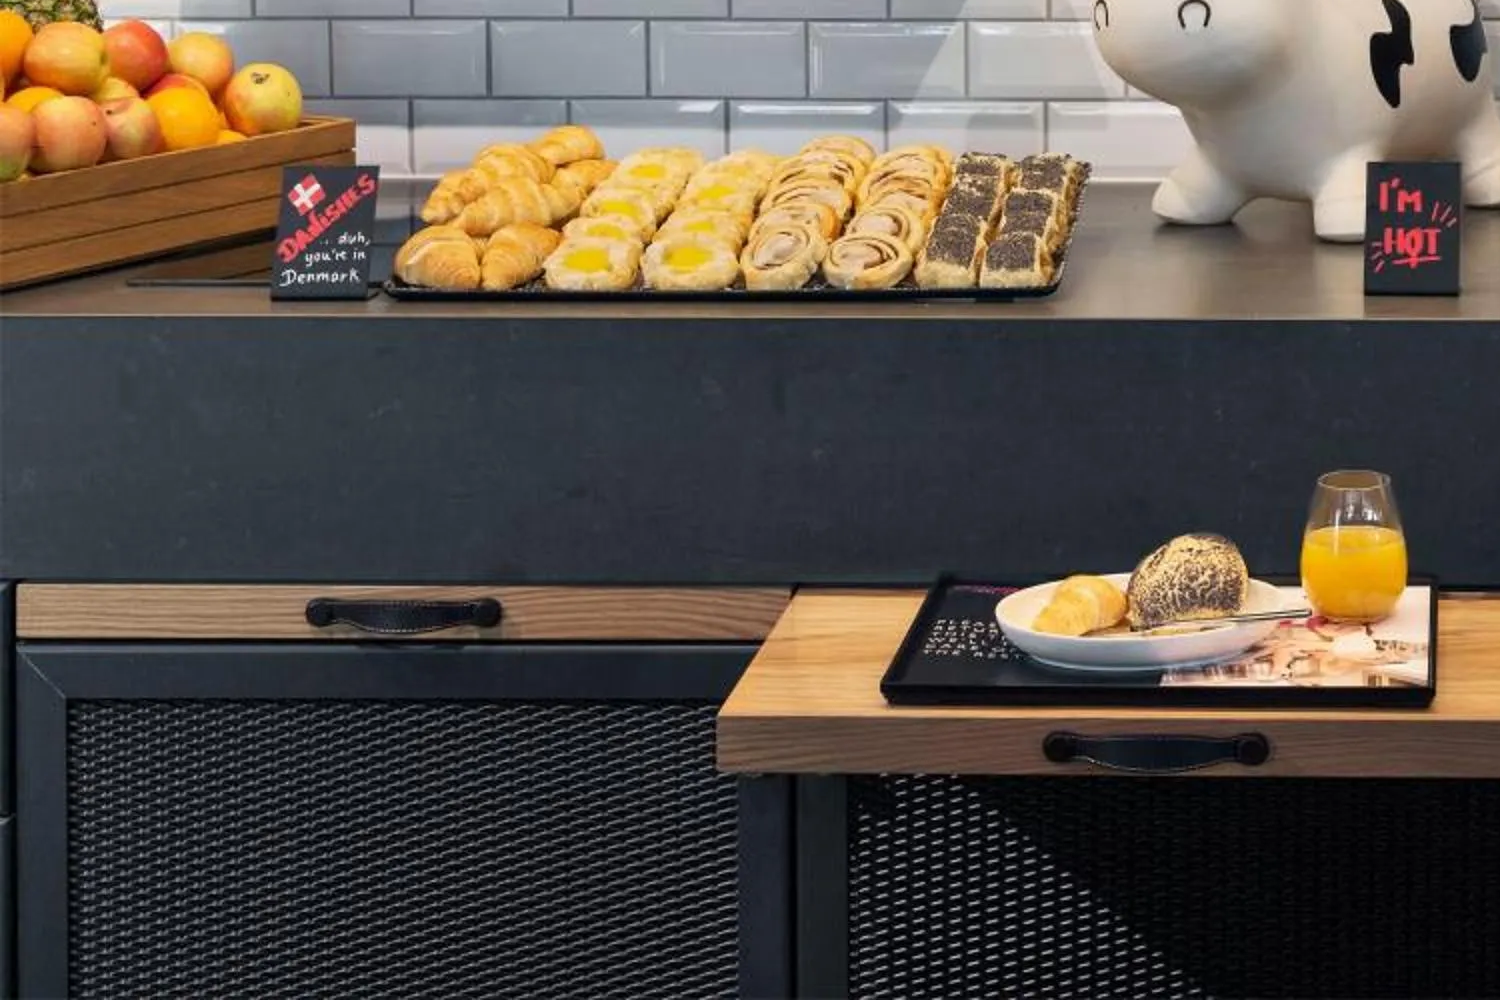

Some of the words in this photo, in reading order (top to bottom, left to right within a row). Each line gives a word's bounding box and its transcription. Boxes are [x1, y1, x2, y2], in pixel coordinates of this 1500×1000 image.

[1383, 227, 1442, 257] HOT
[305, 248, 348, 268] you're
[353, 247, 366, 261] in
[279, 267, 361, 287] Denmark
[937, 619, 997, 628] PLEAS
